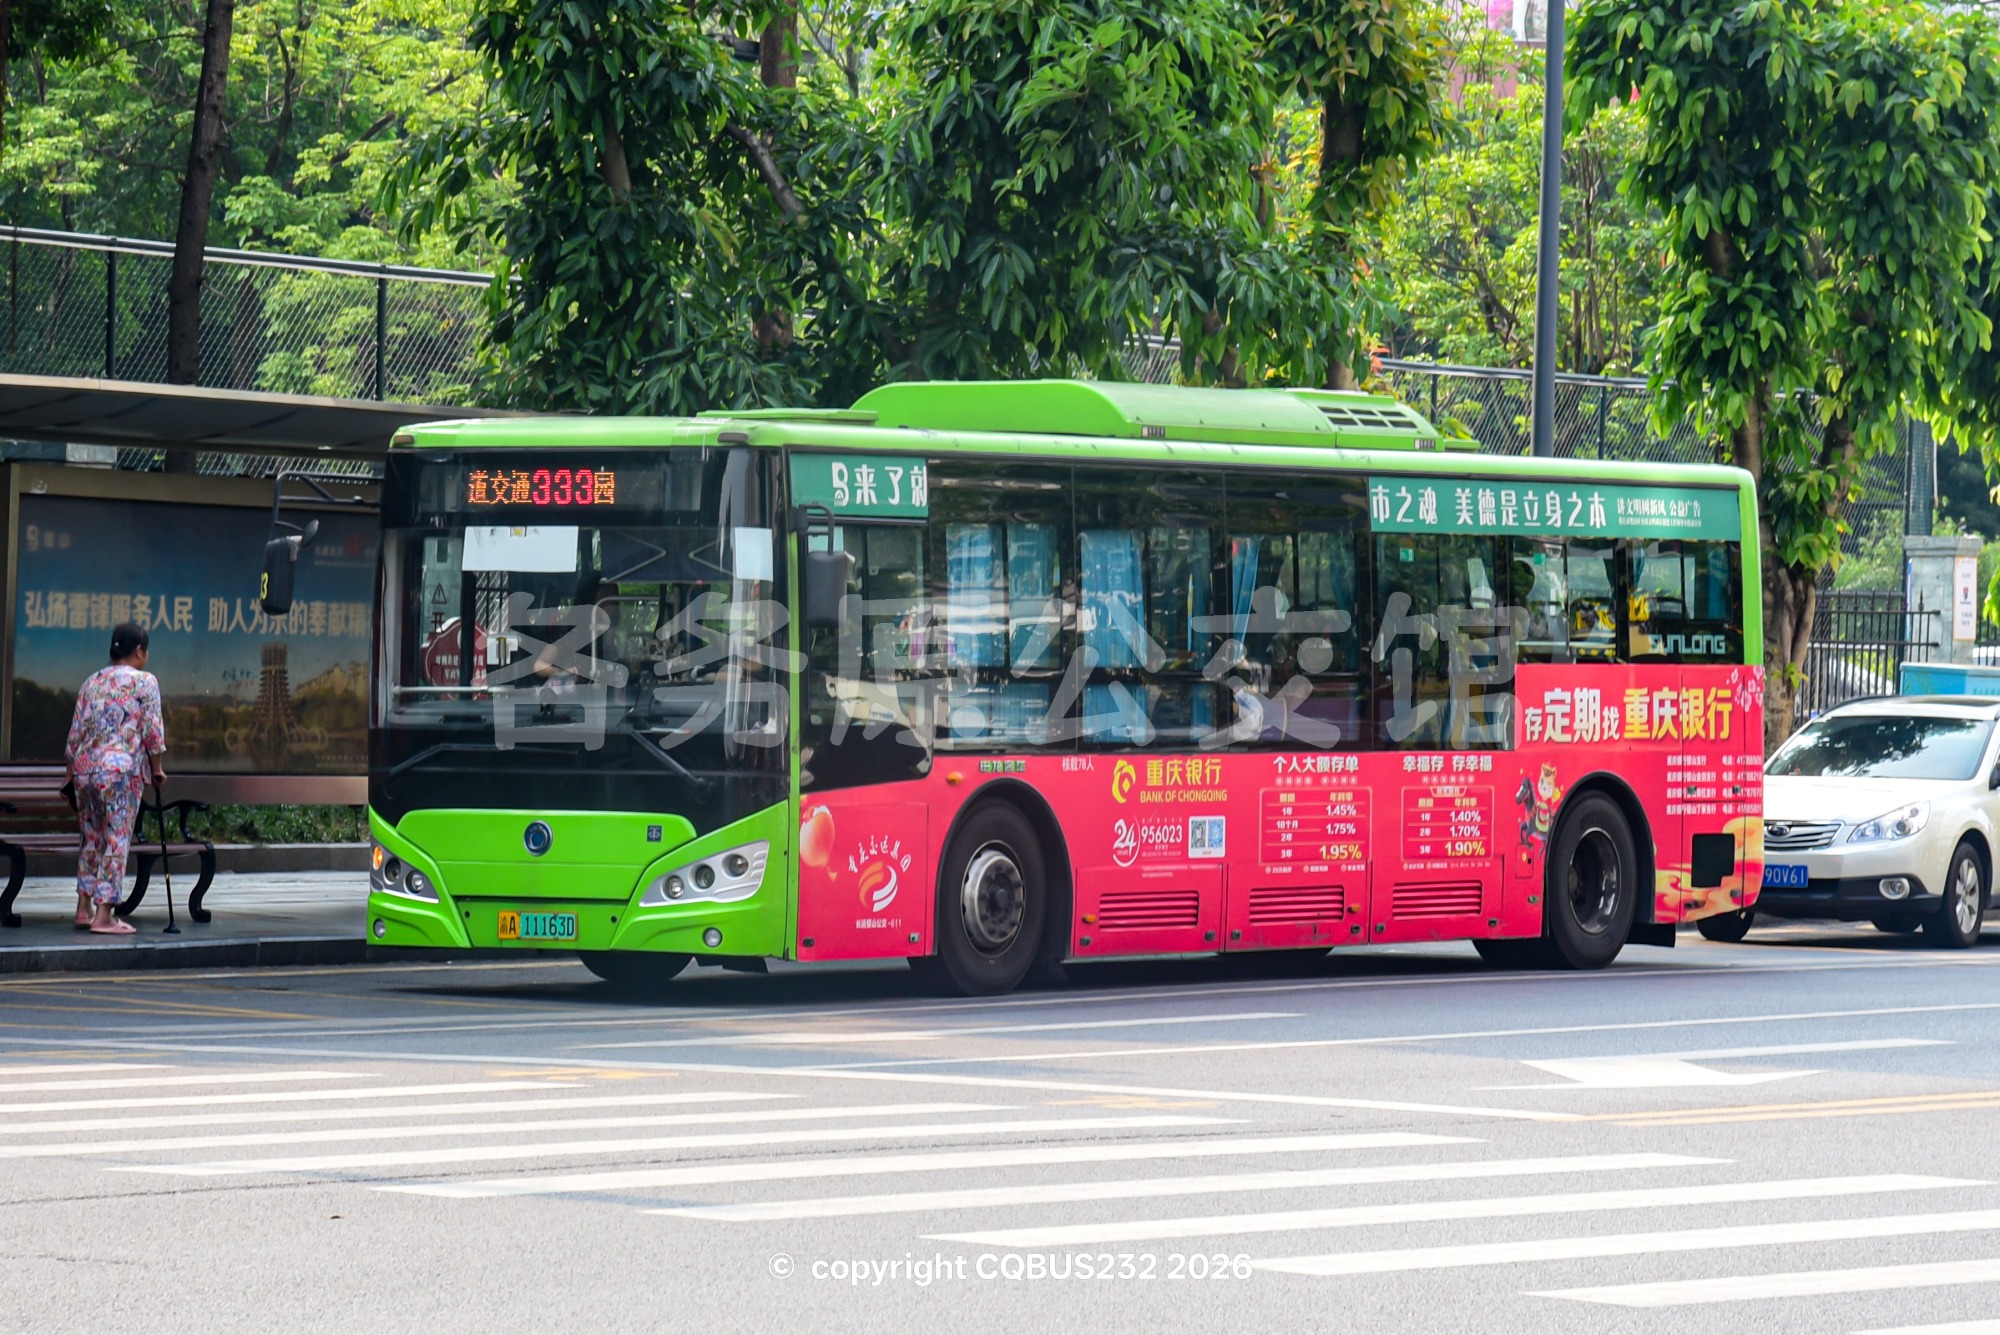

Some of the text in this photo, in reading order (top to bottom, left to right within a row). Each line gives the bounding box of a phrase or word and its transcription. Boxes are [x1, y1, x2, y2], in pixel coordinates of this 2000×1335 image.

[1371, 484, 1607, 529] 市之魂 美德是立身之本
[25, 591, 371, 638] 弘扬雷锋服务人民 助人为乐的奉献精
[1273, 756, 1359, 774] 个人大额存单
[1403, 755, 1492, 772] 幸福存 存幸福
[1146, 758, 1222, 786] 重庆银行
[1140, 789, 1227, 803] BANK OF CHONGQING
[1326, 804, 1356, 816] 1.45%
[1450, 811, 1481, 822] 1.40%
[1141, 825, 1182, 844] 956023
[1326, 823, 1356, 835] 1.75%
[1450, 825, 1480, 837] 1.70%
[1319, 844, 1362, 860] 1.95%
[1445, 841, 1485, 856] 1.90%
